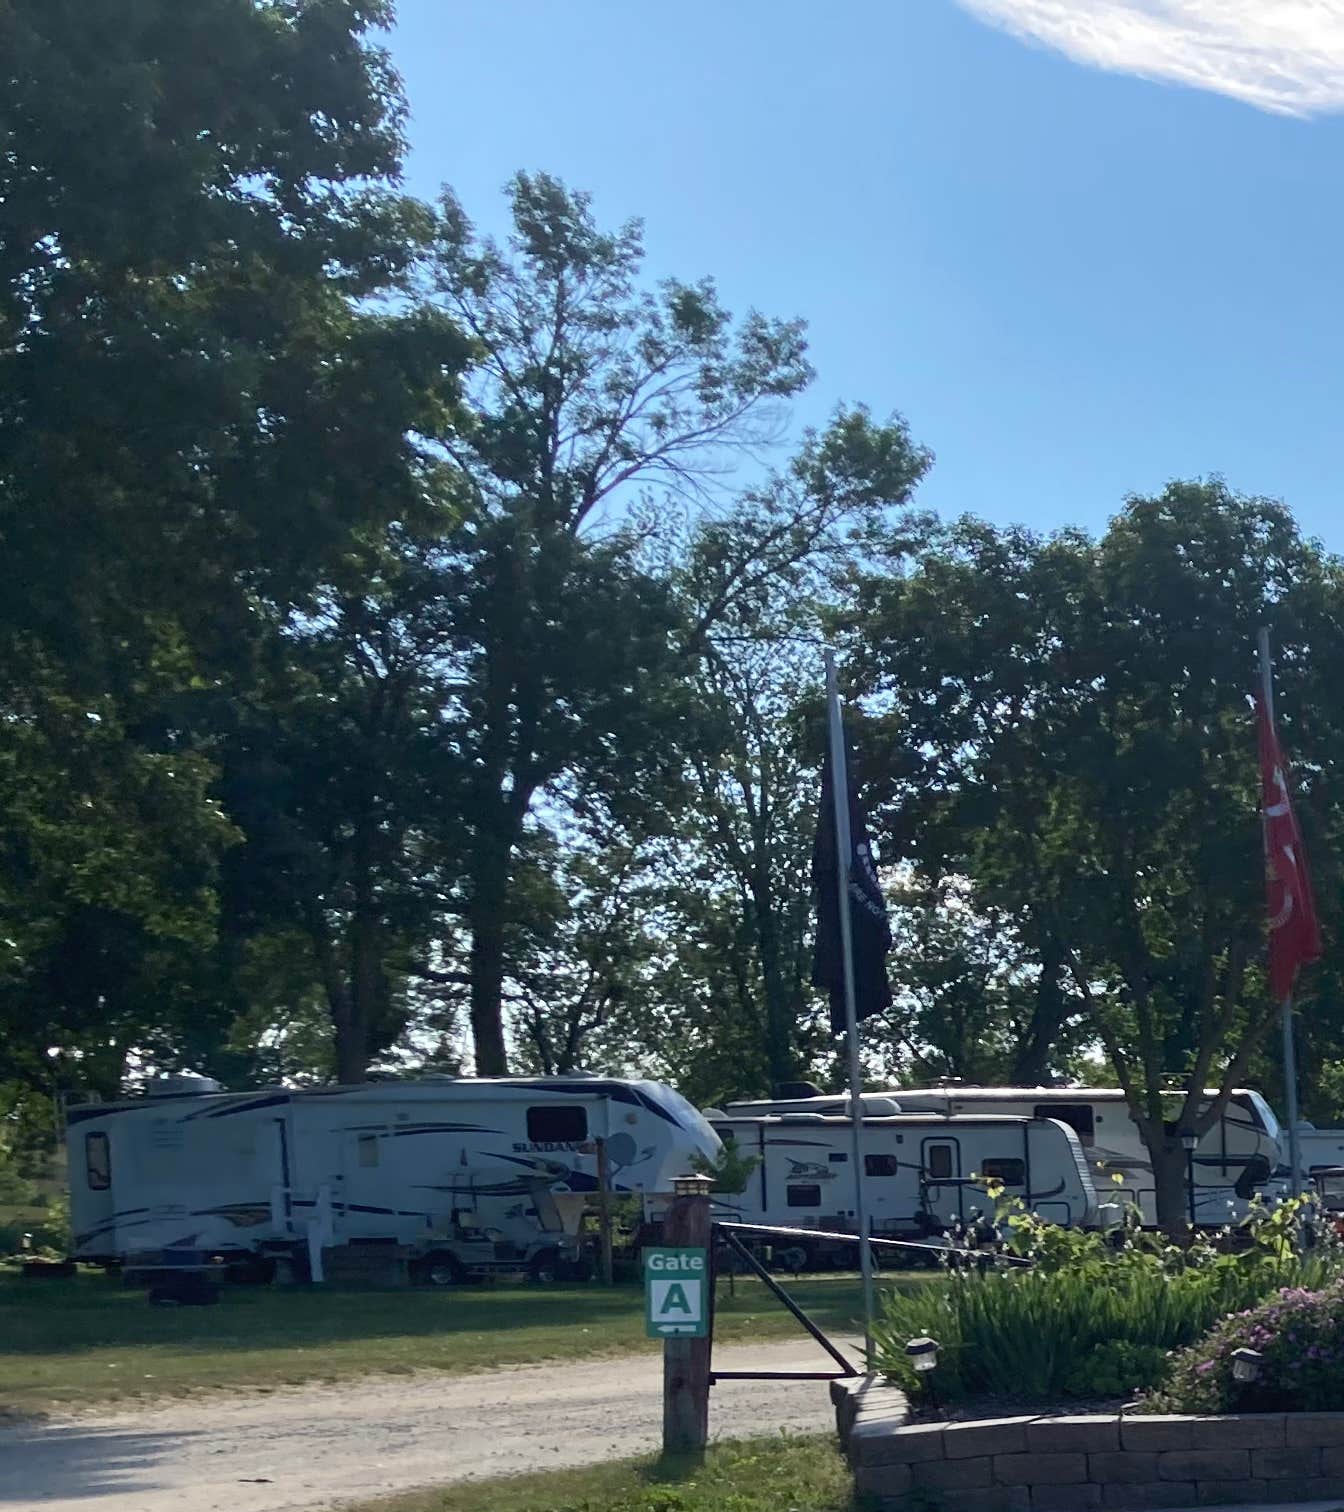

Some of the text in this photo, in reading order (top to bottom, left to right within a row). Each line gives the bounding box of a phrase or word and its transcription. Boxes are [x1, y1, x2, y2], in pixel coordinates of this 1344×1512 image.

[512, 1142, 577, 1153] SUNDAN
[648, 1253, 704, 1271] Gate
[659, 1282, 693, 1314] A
